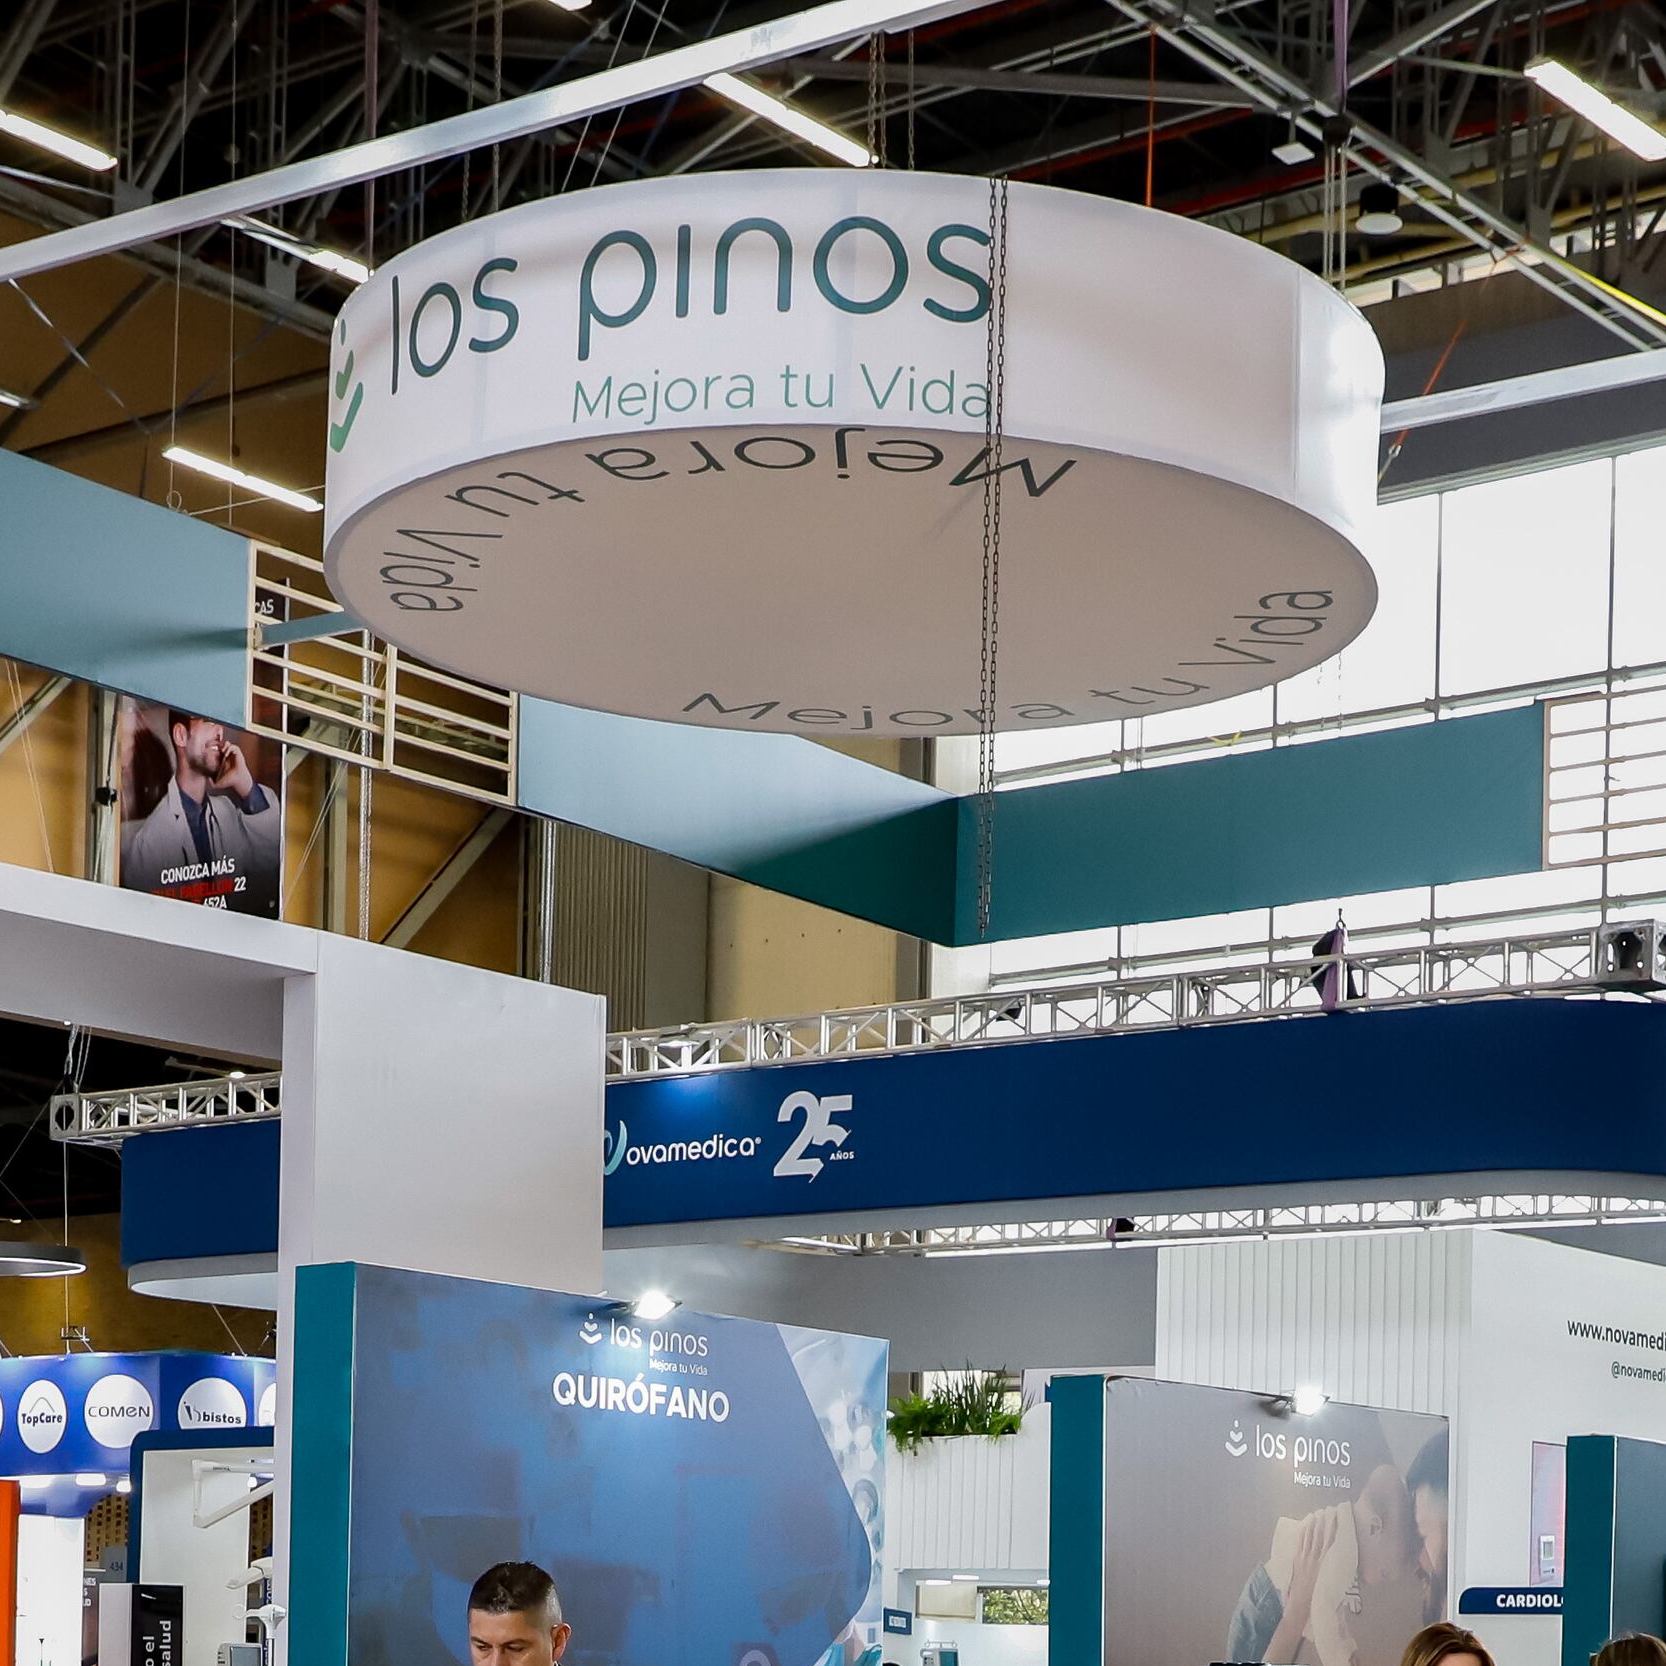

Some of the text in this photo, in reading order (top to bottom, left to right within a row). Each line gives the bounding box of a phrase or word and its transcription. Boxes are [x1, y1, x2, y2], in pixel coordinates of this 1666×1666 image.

[391, 215, 994, 396] los pinos
[572, 363, 993, 426] Mejora tu Vida
[379, 426, 1079, 613] Mejora tu Vida
[682, 589, 1335, 732] Mejora tu Vida
[160, 855, 236, 885] CONOZCA MÁS
[234, 876, 247, 892] 22
[773, 1090, 853, 1184] 25
[610, 1318, 709, 1357] los pinos
[649, 1357, 709, 1377] Mejora tu Vida
[552, 1371, 731, 1424] QUIRÓFANO
[21, 1412, 63, 1427] TopCare
[201, 1410, 243, 1425] bistos
[1256, 1424, 1351, 1468] los pinos
[1293, 1471, 1351, 1489] Mejora tu Vida
[110, 1561, 124, 1573] 434
[1496, 1593, 1564, 1608] CARDIOL
[142, 1635, 155, 1647] el
